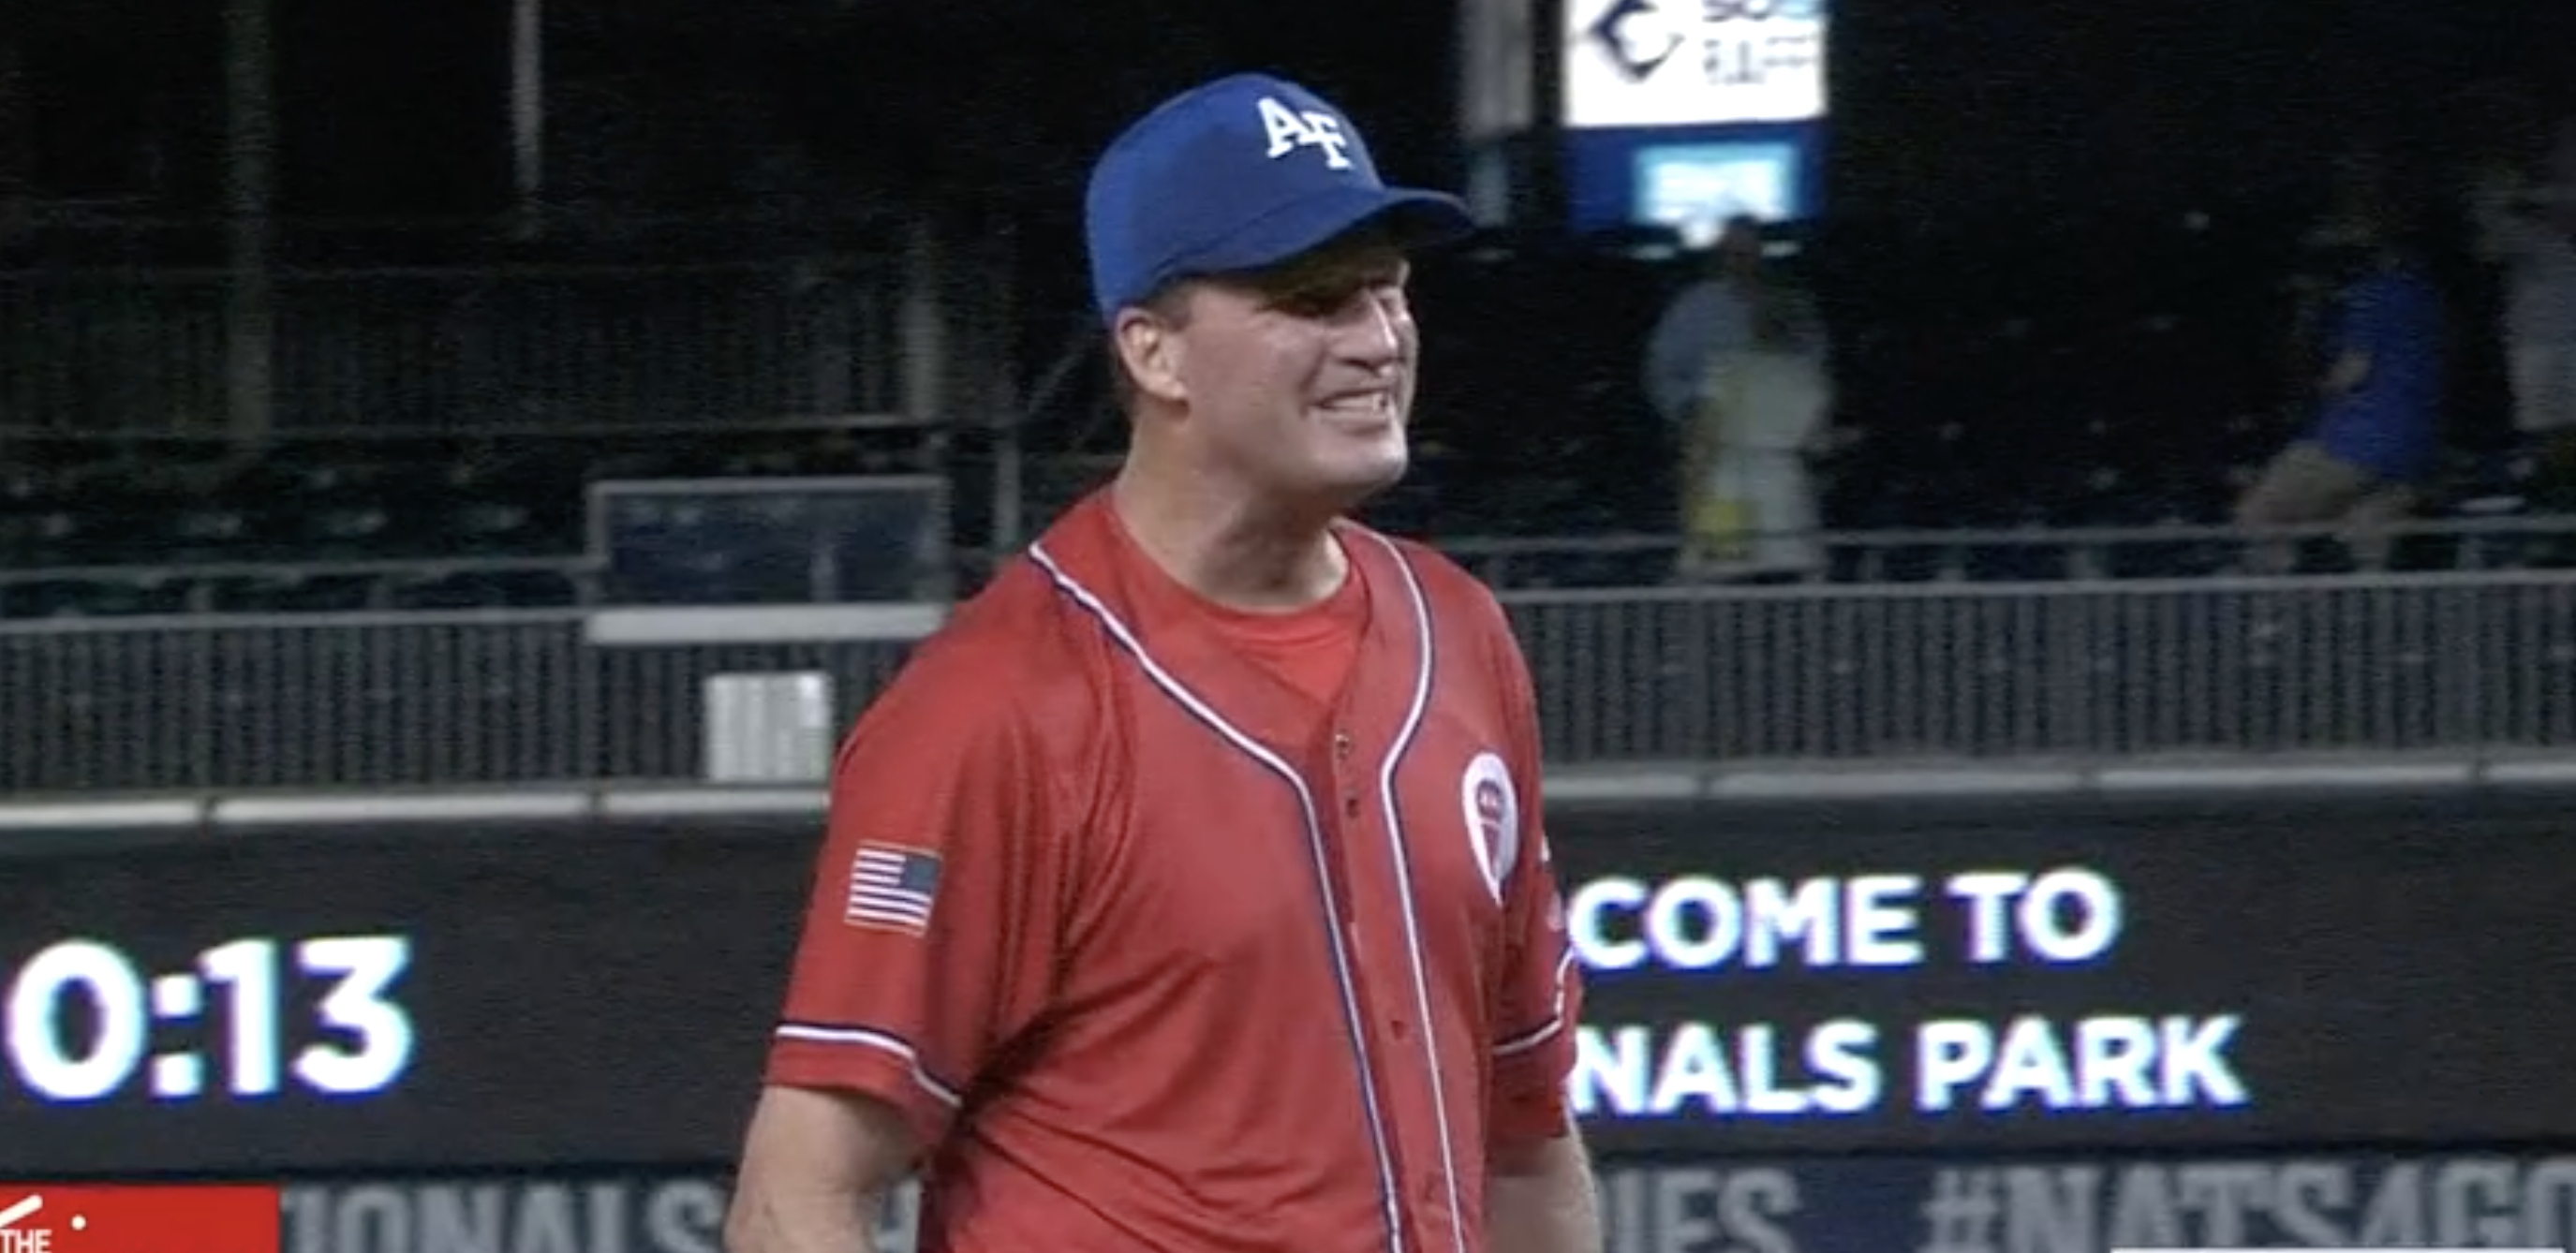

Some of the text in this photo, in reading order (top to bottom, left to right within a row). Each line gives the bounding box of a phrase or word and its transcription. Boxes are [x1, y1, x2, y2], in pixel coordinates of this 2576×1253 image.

[1257, 97, 1353, 170] AF
[1568, 868, 2121, 970] COME TO
[7, 937, 413, 1100] 0:13
[1572, 1015, 2246, 1114] NALS PARK
[281, 1182, 725, 1253] IONALS
[1596, 1168, 1799, 1253] IES
